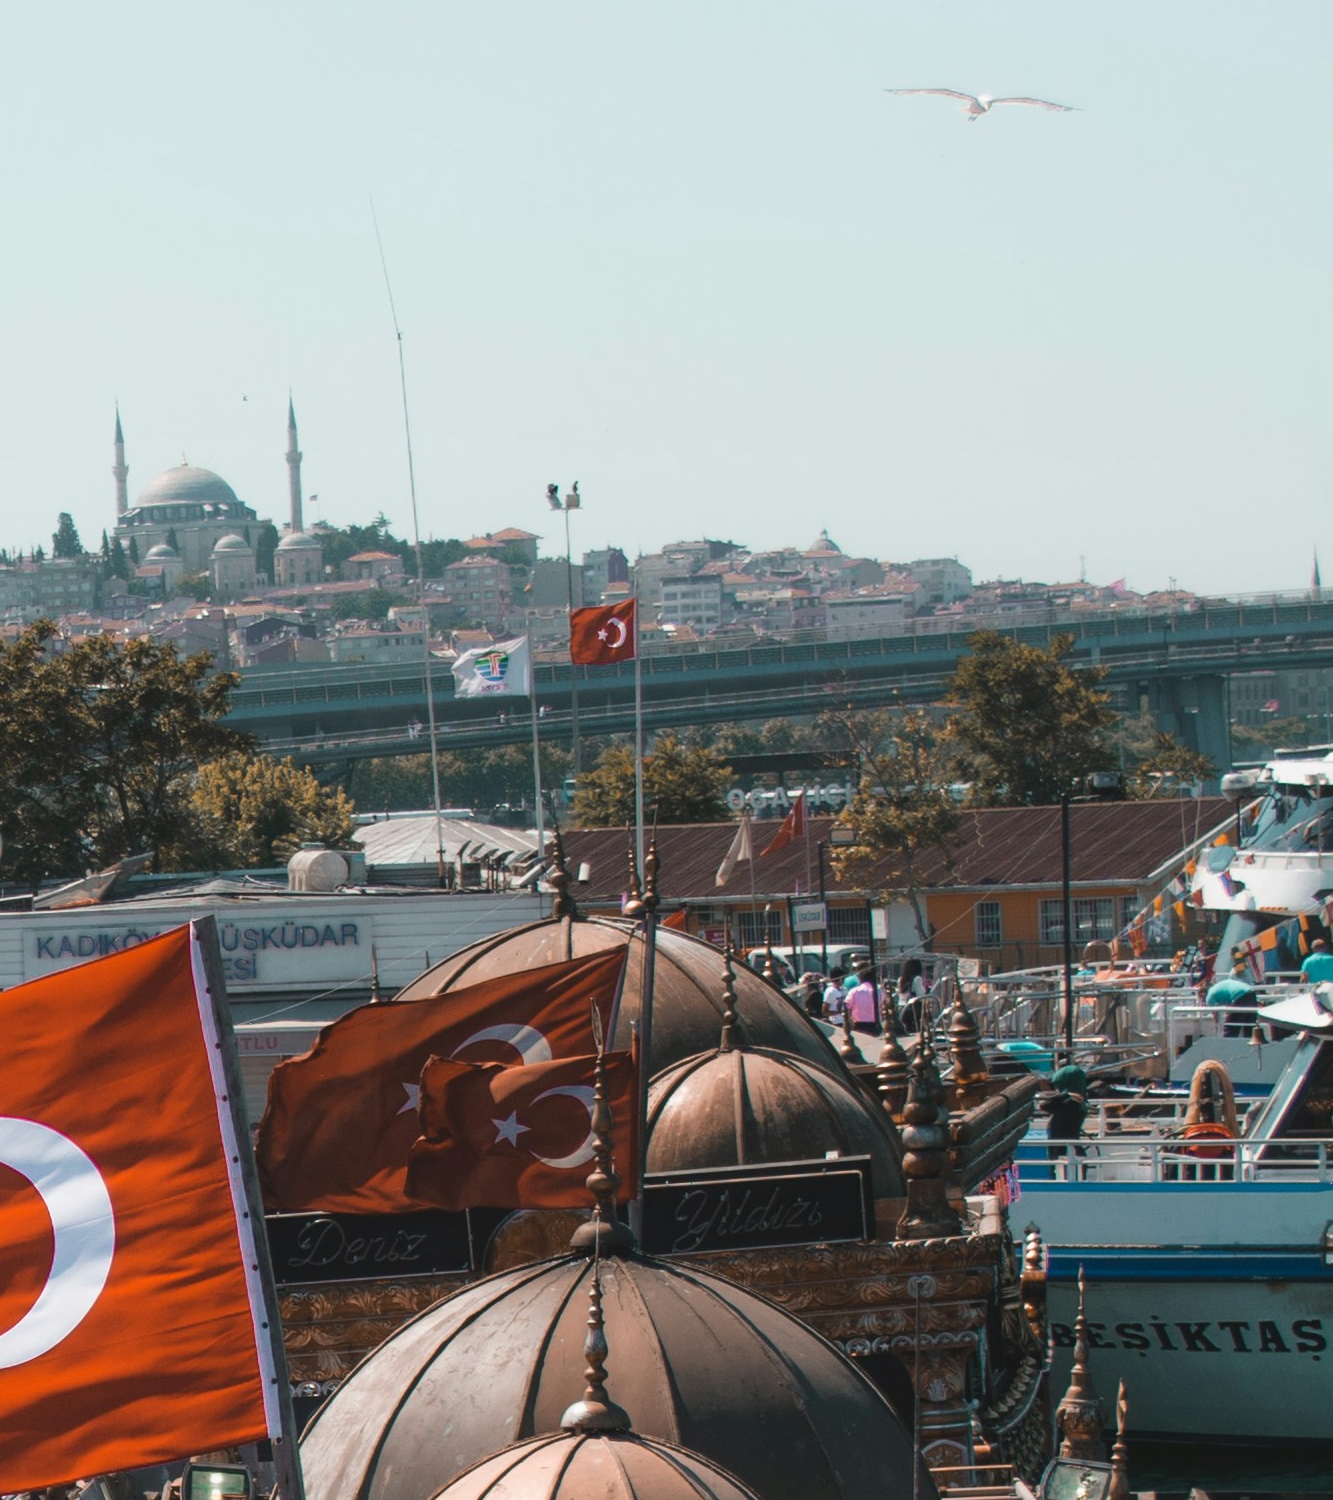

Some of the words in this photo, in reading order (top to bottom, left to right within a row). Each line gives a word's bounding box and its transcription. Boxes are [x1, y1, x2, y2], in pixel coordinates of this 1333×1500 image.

[37, 932, 159, 960] KADIKÖ
[221, 924, 359, 951] ÜSKÜDAR
[288, 1218, 428, 1268] Deniz
[1050, 1315, 1328, 1361] BEŞİKTAŞ
